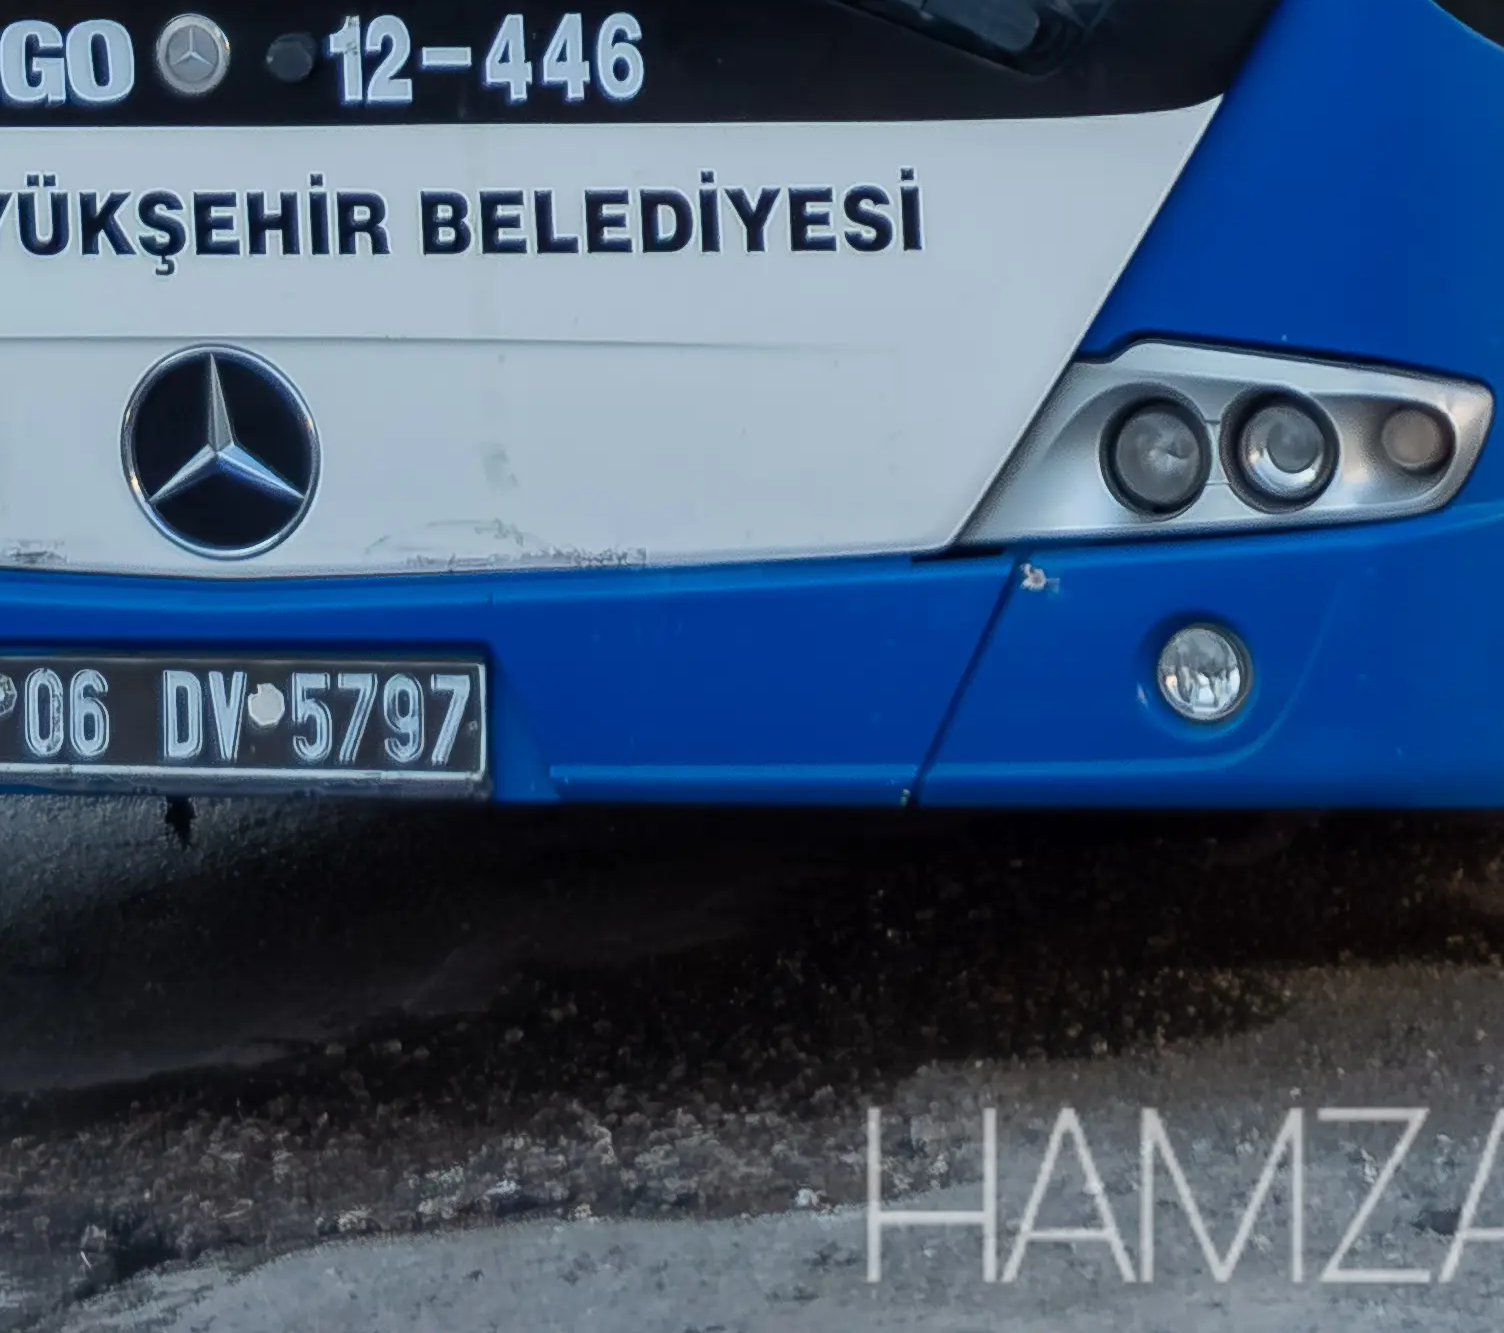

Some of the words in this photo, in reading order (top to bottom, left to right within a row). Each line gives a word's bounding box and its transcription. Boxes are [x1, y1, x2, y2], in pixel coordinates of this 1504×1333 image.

[328, 11, 645, 104] 12-446
[420, 167, 923, 256] BELEDİYESİ
[23, 667, 110, 758] 06
[162, 669, 247, 762] DV
[291, 671, 471, 765] 5797
